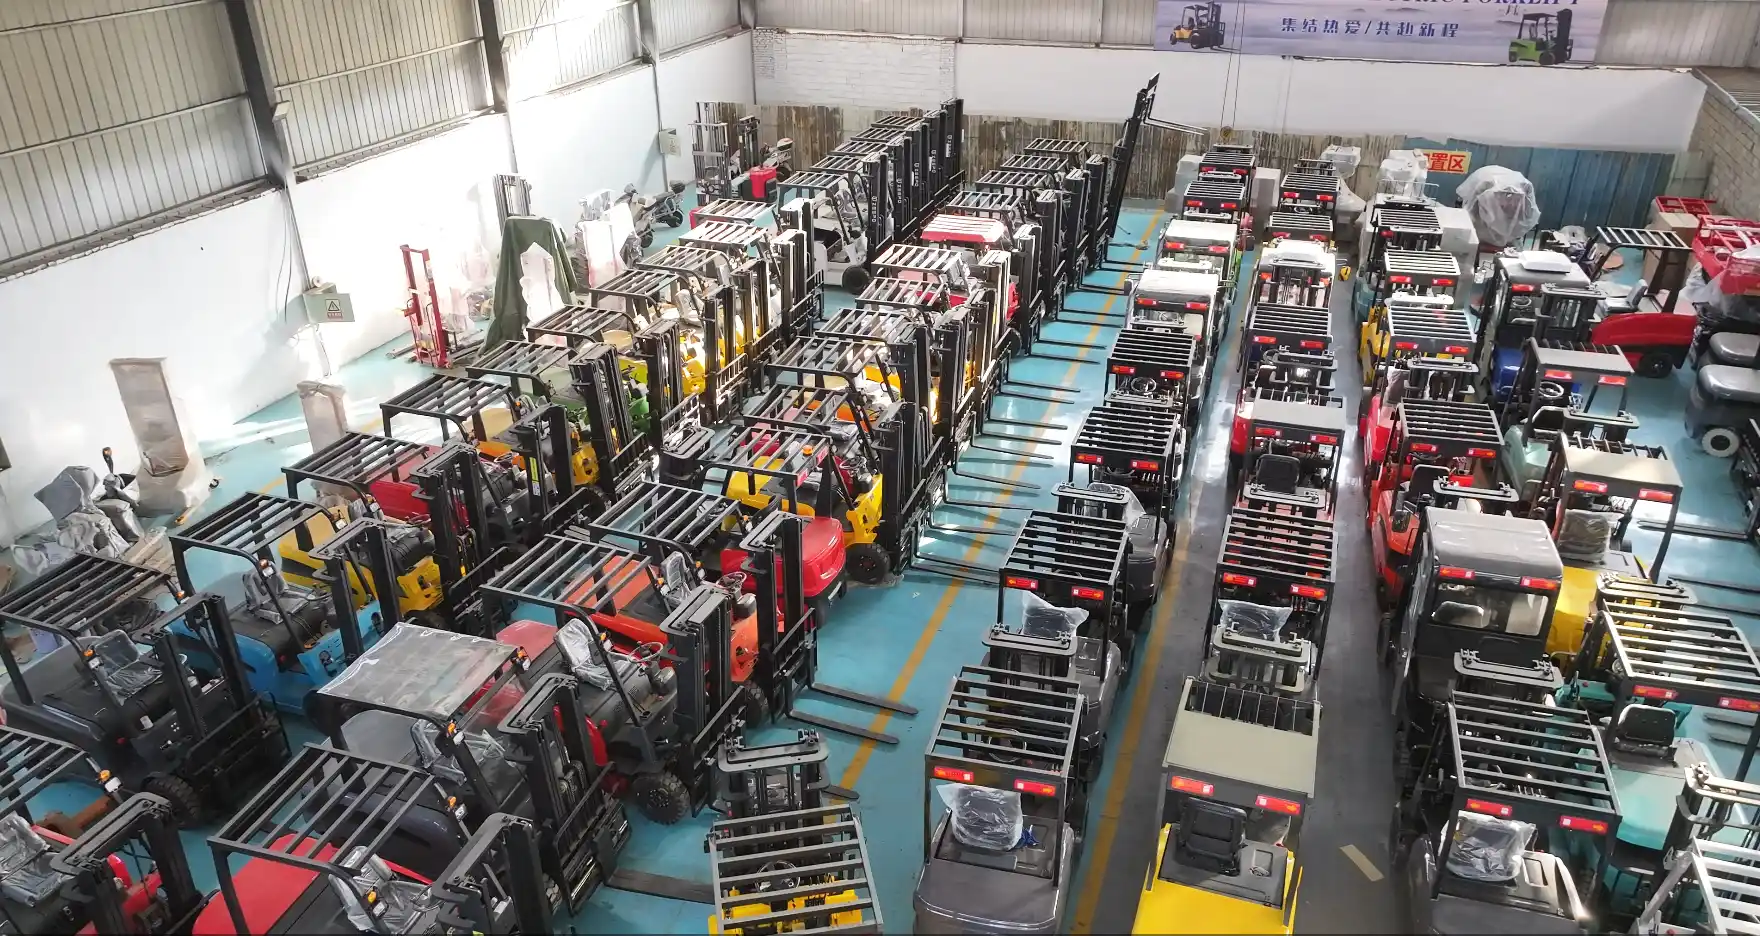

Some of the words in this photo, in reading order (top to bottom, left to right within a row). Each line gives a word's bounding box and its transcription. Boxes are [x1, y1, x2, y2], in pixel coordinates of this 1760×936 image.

[1281, 17, 1459, 38] 集结热爱/共赴新程
[1424, 152, 1466, 173] 置区
